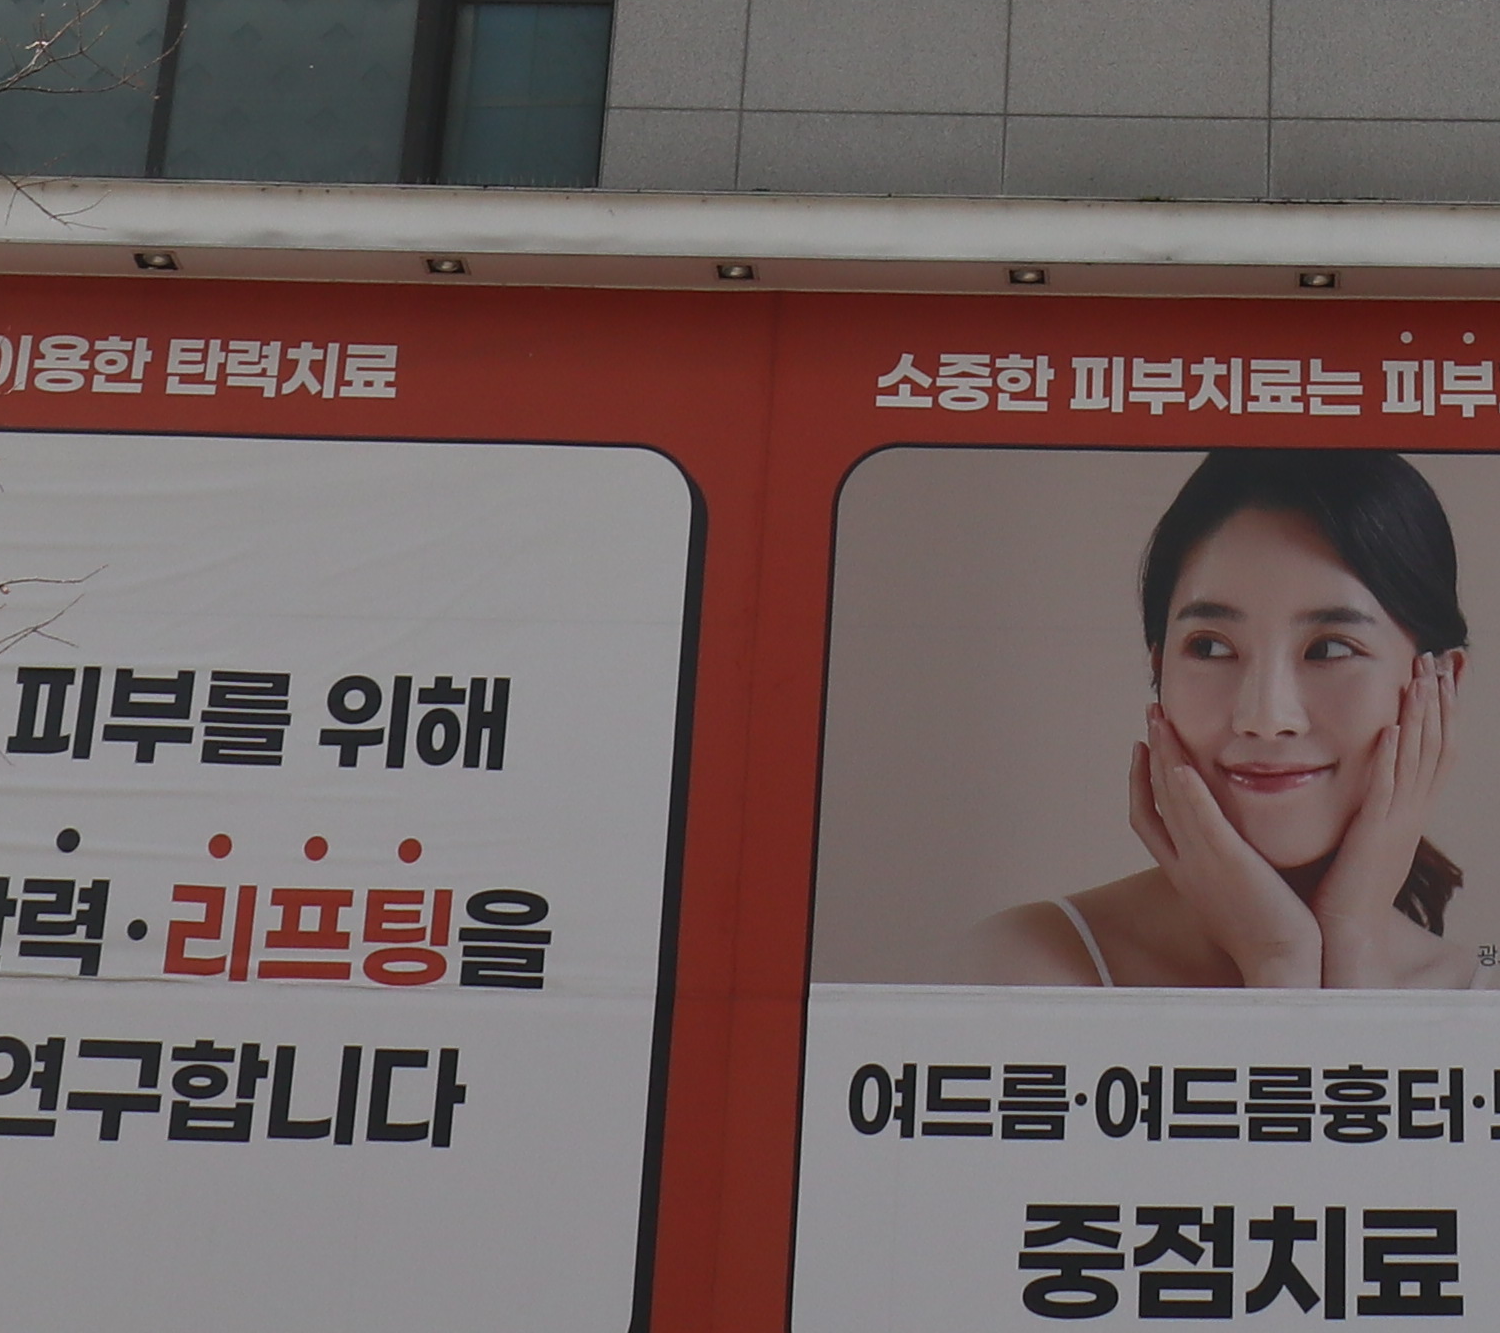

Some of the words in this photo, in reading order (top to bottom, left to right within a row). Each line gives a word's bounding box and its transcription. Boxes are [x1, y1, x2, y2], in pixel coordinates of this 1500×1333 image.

[162, 338, 399, 400] 탄력치료
[873, 351, 1057, 415] 소중한
[1067, 353, 1364, 417] 피부치료는
[6, 665, 293, 767] 피부를
[319, 674, 512, 771] 위해
[1016, 1204, 1465, 1321] 중점치료
